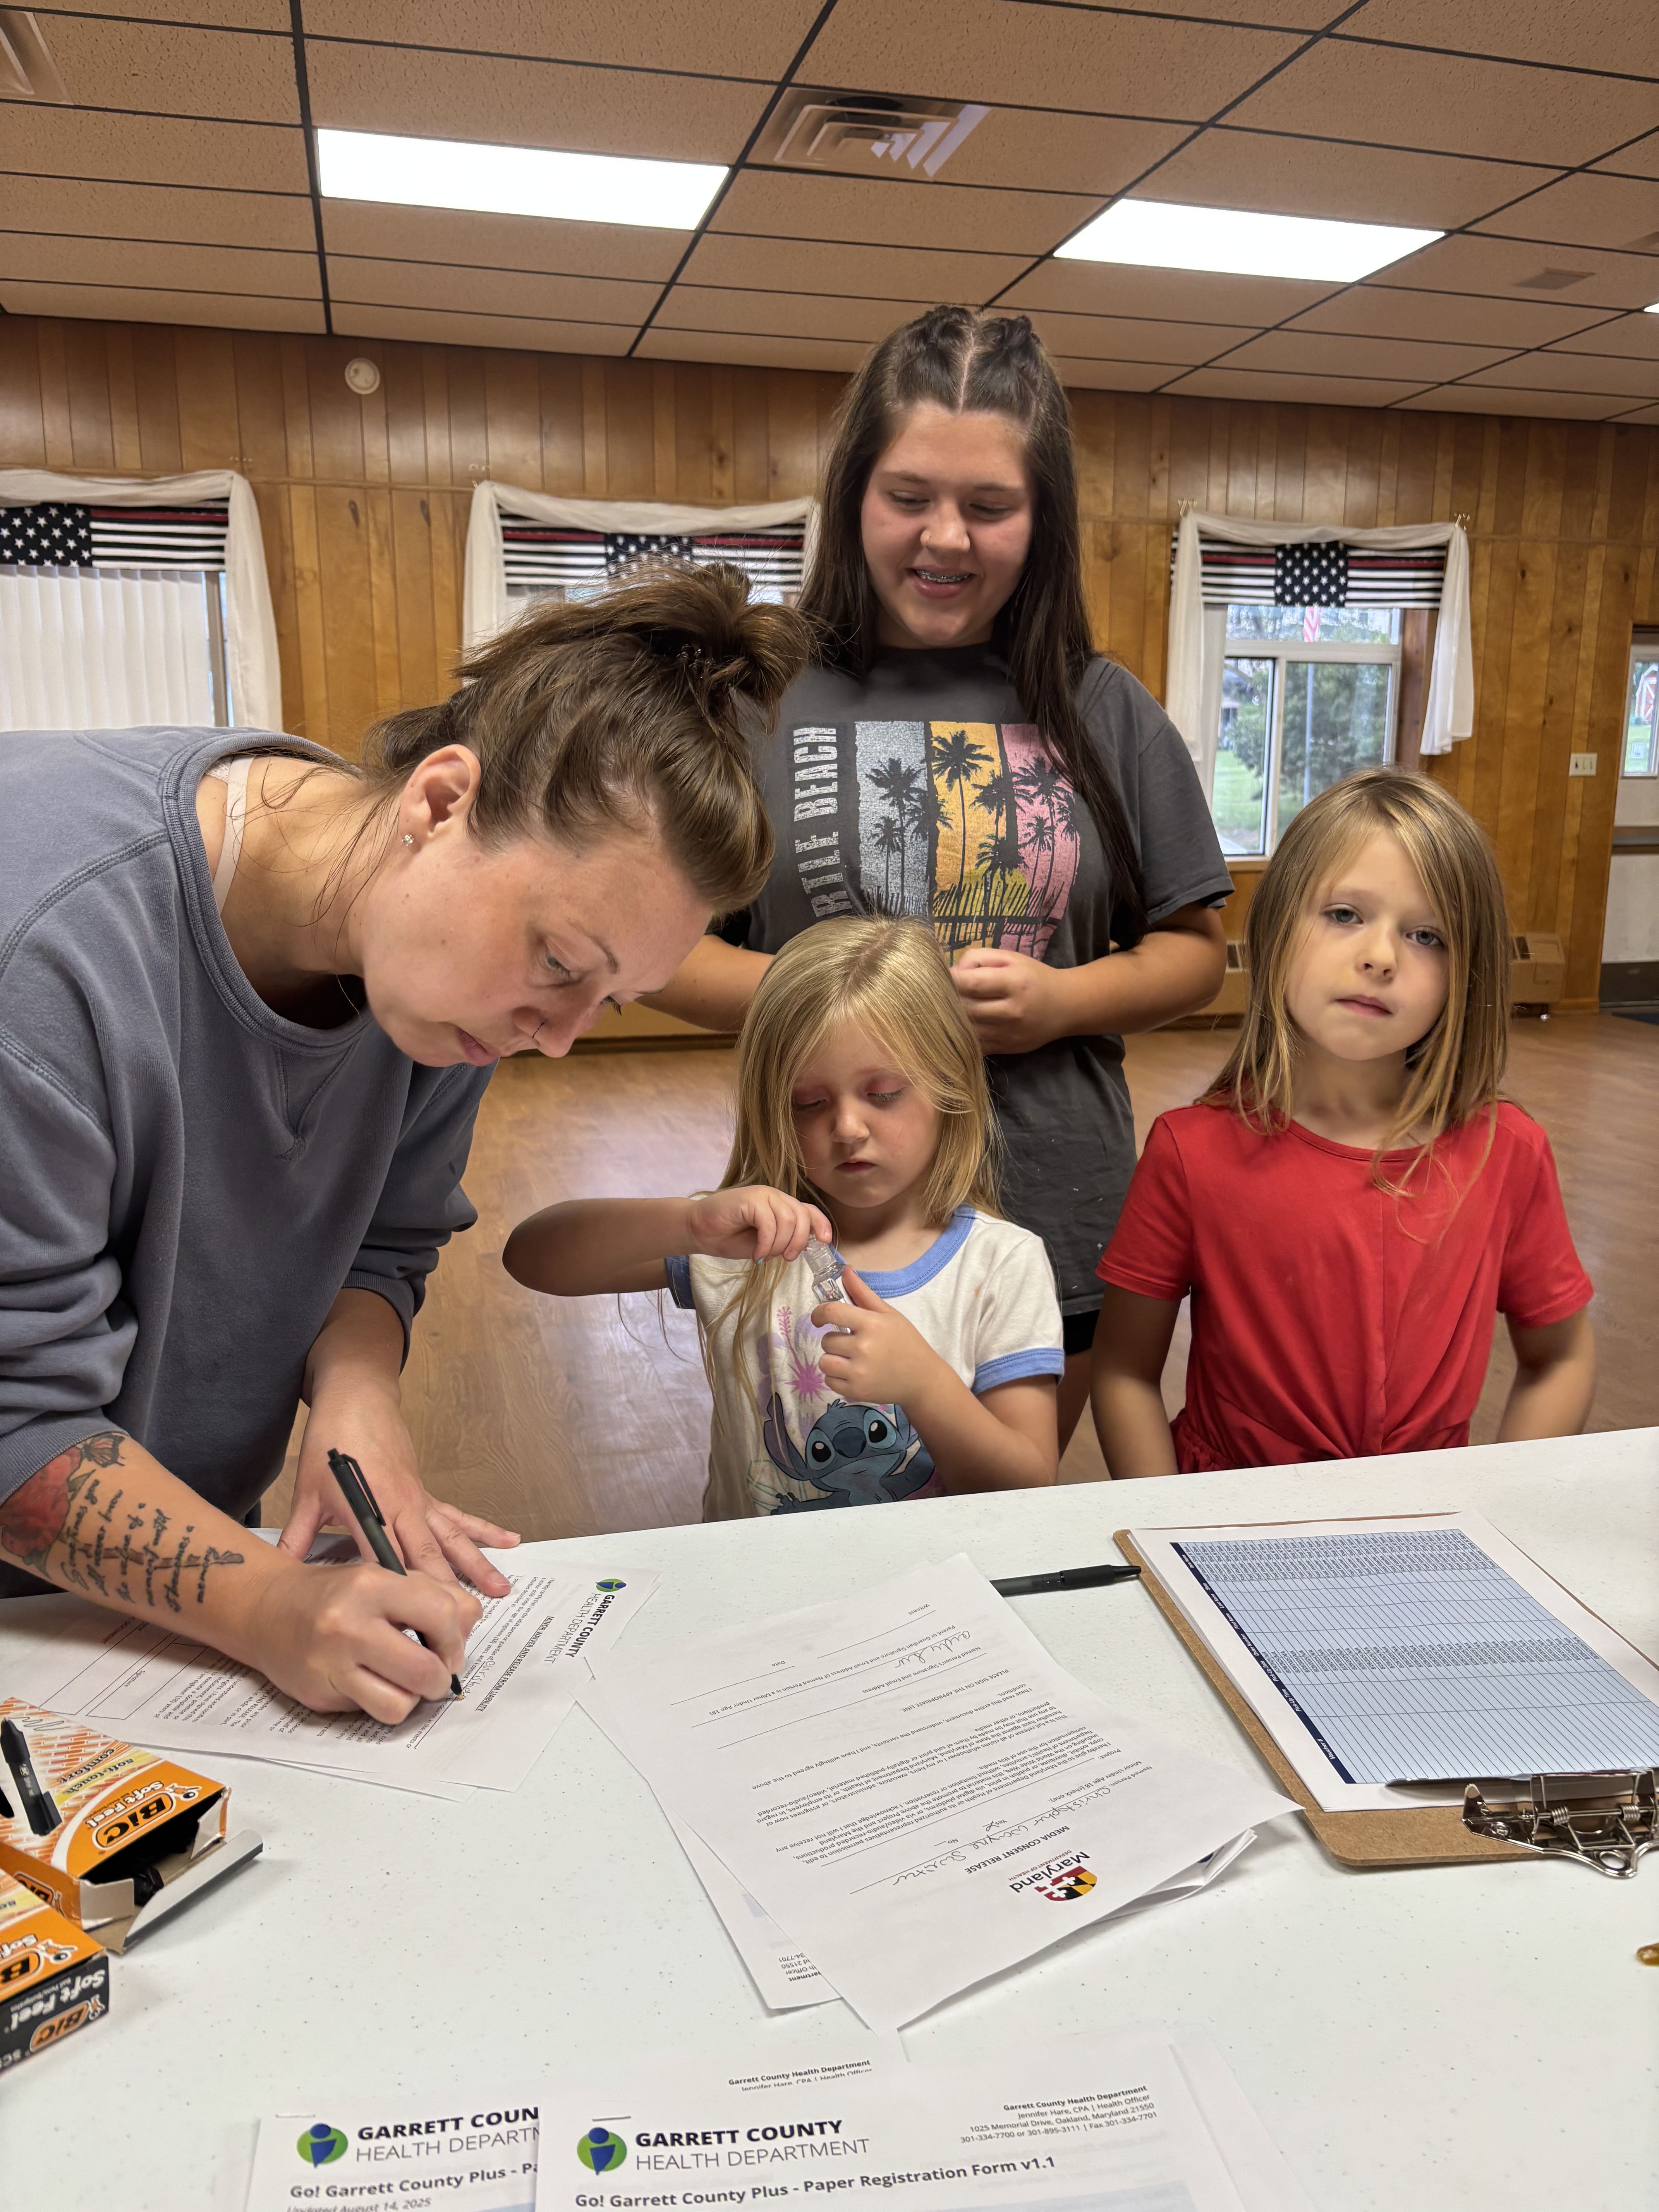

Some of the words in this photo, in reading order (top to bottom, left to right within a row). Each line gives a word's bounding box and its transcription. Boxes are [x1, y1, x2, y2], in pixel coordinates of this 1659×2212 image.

[793, 727, 838, 822] BEACH
[795, 831, 852, 918] RTLE
[84, 1479, 100, 1506] you
[98, 1489, 124, 1523] know
[127, 1513, 143, 1530] of
[93, 1525, 107, 1567] never
[196, 1546, 219, 1604] memory
[576, 1593, 600, 1618] HEALTH
[587, 1594, 615, 1626] GARRETT
[907, 1603, 930, 1615] Witness
[538, 1615, 555, 1631] MINOR
[936, 1625, 956, 1635] Parent
[526, 1631, 544, 1648] WAIVER
[543, 1618, 583, 1664] DEPARTMENT
[565, 1626, 594, 1658] COUNTY
[905, 1636, 931, 1649] Guardian
[518, 1647, 531, 1658] AND
[880, 1646, 907, 1658] Signature
[938, 1654, 962, 1666] Person's
[960, 1646, 981, 1657] Named
[504, 1658, 523, 1677] RELEASE
[830, 1666, 853, 1676] Address
[853, 1660, 870, 1669] Email
[912, 1664, 939, 1676] Signature
[802, 1676, 824, 1685] Named
[884, 1678, 902, 1686] Email
[974, 1677, 989, 1685] SIGN
[988, 1668, 1009, 1680] PLEASE
[492, 1676, 509, 1691] FROM
[781, 1682, 803, 1691] Person
[861, 1683, 885, 1693] Address
[477, 1690, 498, 1712] LIABILITY
[733, 1698, 753, 1707] Under
[752, 1692, 772, 1701] Minor
[914, 1690, 953, 1707] APPROPRIATE
[899, 1704, 915, 1712] LINE.
[1097, 1748, 1121, 1759] Project:
[58, 1748, 115, 1784] comfort
[1105, 1769, 1125, 1779] Under
[1123, 1760, 1142, 1771] Minor
[1130, 1765, 1153, 1778] Named
[64, 1759, 134, 1794] soft-touch
[1108, 1775, 1132, 1787] Person:
[124, 1781, 164, 1804] Soft
[1048, 1794, 1065, 1803] one):
[1064, 1785, 1086, 1796] (check
[85, 1803, 127, 1827] Feel
[994, 1819, 1008, 1827] Yes
[1039, 1825, 1070, 1841] MEDIA
[1001, 1838, 1041, 1859] CONSENT
[964, 1855, 1002, 1874] RELEASE
[1037, 1849, 1072, 1869] DEPARTMENT
[1008, 1851, 1091, 1893] Maryland
[1008, 1869, 1030, 1881] HEALTH
[0, 1934, 38, 1958] Sof
[781, 1960, 802, 1969] 21550
[785, 1967, 808, 1975] Officer
[60, 1969, 106, 2003] Soft
[11, 1994, 55, 2032] Feel
[728, 2076, 759, 2085] Garrett
[760, 2073, 790, 2081] County
[791, 2068, 819, 2077] Health
[820, 2059, 871, 2073] Department
[1003, 2102, 1035, 2111] Garrett
[1035, 2100, 1065, 2108] County
[1066, 2095, 1096, 2105] Health
[1096, 2085, 1148, 2100] Department
[1017, 2110, 1048, 2120] Jennifer
[1049, 2105, 1072, 2116] Hare,
[1072, 2105, 1090, 2113] CPA
[1096, 2100, 1123, 2110] Health
[1124, 2094, 1150, 2105] Officer
[969, 2124, 990, 2133] 1025
[990, 2120, 1029, 2130] Memorial
[1054, 2114, 1091, 2124] Oakland,
[1091, 2107, 1129, 2119] Maryland
[1129, 2102, 1154, 2113] 21550
[357, 2116, 464, 2140] GARRETT
[635, 2129, 740, 2147] GARRETT
[746, 2119, 842, 2142] COUNTY
[960, 2131, 1015, 2143] 301-334-7700
[1026, 2124, 1080, 2136] 301-895-3111
[1104, 2111, 1157, 2127] 301-334-7701
[355, 2141, 441, 2162] HEALTH
[636, 2152, 720, 2171] HEALTH
[727, 2138, 869, 2167] DEPARTMENT
[290, 2185, 320, 2198] Go!
[325, 2182, 393, 2198] Garrett
[398, 2175, 464, 2192] County
[469, 2169, 506, 2183] Plus
[575, 2195, 605, 2207] Go!
[610, 2194, 677, 2207] Garrett
[682, 2190, 746, 2205] County
[751, 2185, 788, 2199] Plus
[803, 2178, 855, 2193] Paper
[859, 2167, 967, 2188] Registration
[970, 2162, 1017, 2176] Form
[1020, 2156, 1055, 2170] v1.1
[402, 2197, 431, 2210] 2025
